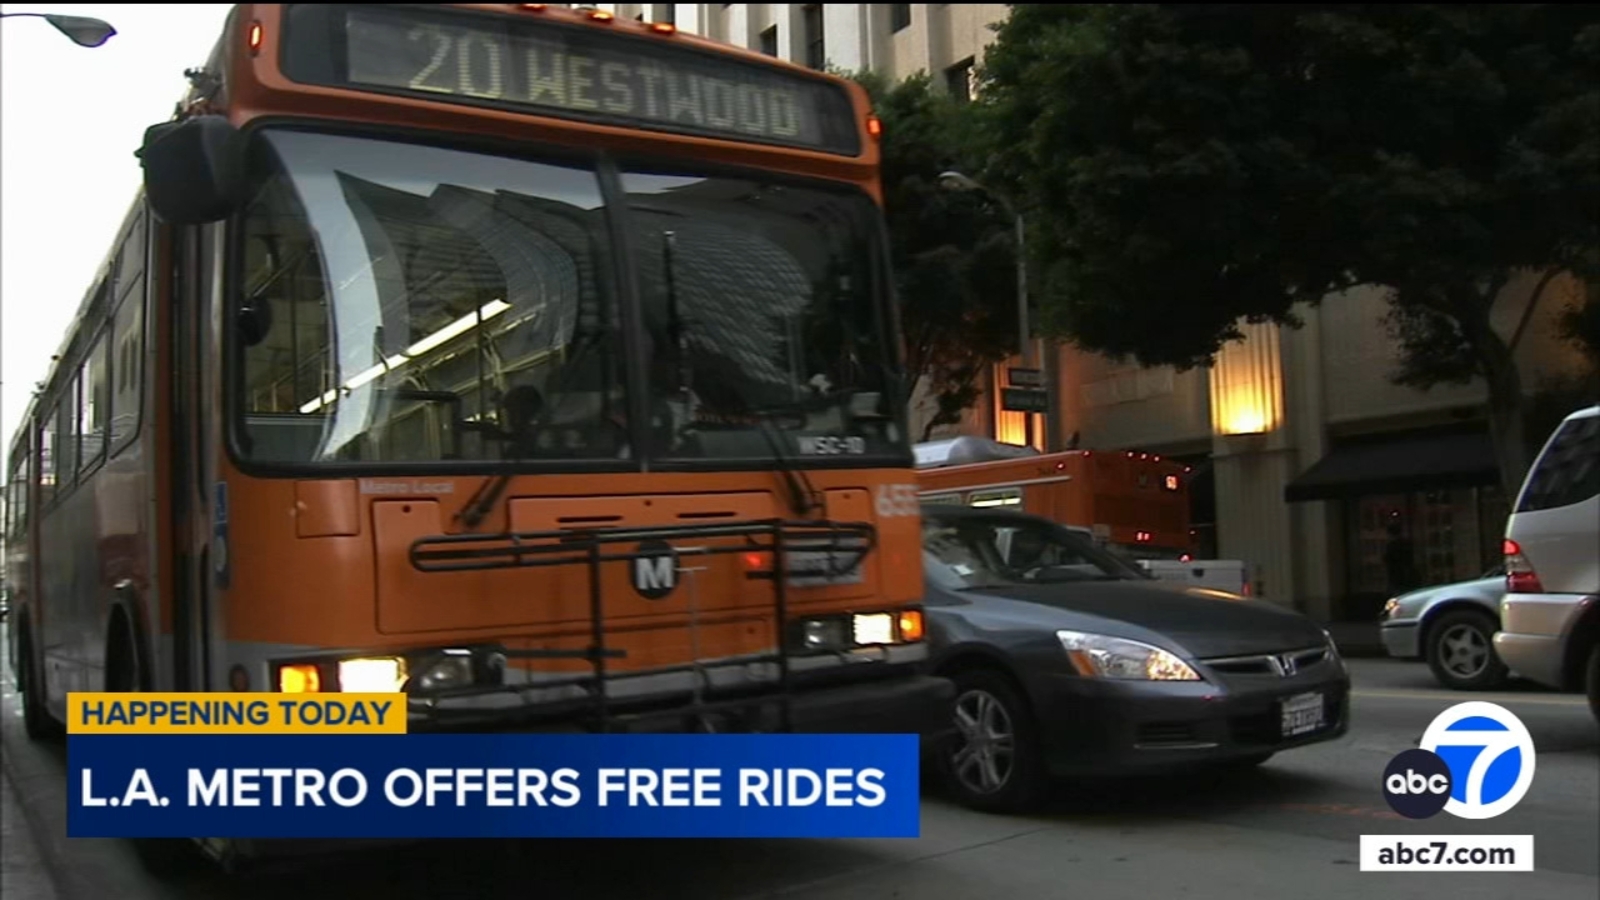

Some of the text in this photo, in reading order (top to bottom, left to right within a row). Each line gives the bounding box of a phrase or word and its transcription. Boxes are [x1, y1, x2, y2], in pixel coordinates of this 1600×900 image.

[408, 24, 797, 137] 20 WESTWOOD
[360, 478, 454, 494] Metro Local
[635, 553, 674, 591] M
